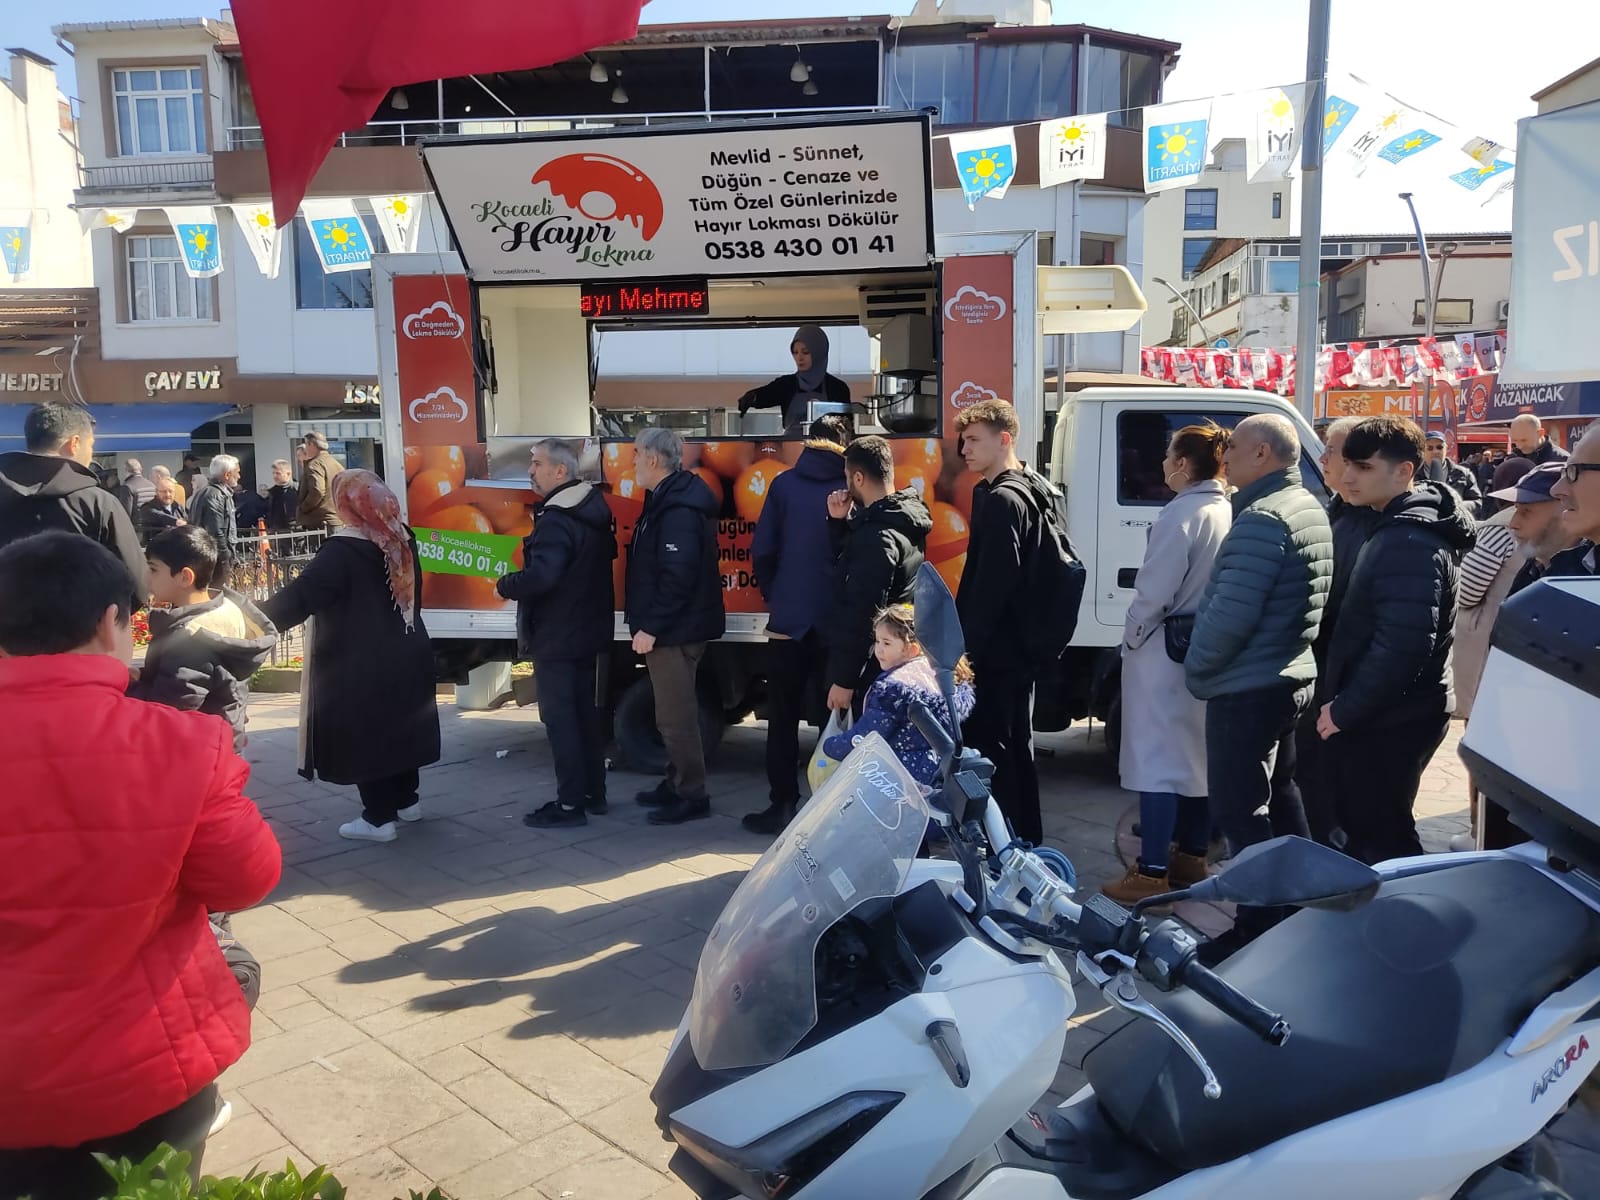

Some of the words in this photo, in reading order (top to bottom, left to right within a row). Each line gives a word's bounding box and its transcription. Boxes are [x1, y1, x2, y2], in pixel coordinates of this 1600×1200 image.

[710, 148, 771, 166] Mevlid
[793, 144, 864, 162] Sünnet,
[701, 173, 762, 191] Düğün
[783, 170, 851, 185] Cenaze
[857, 170, 879, 181] ve
[471, 198, 554, 226] Kocaeli
[689, 197, 727, 212] Tüm
[734, 193, 773, 210] Özel
[780, 189, 897, 207] Günlerinizde
[492, 216, 616, 254] Hayır
[694, 219, 742, 235] Hayır
[749, 216, 821, 231] Lokması
[828, 212, 899, 227] Dökülür
[576, 245, 655, 267] Lokma
[705, 240, 765, 259] 0538
[774, 238, 822, 257] 430
[832, 236, 858, 255] 01
[869, 235, 894, 253] 41
[620, 287, 706, 310] Mehme
[422, 320, 454, 330] Değmeden
[144, 371, 182, 397] ÇAY
[185, 364, 221, 390] EVİ
[1494, 385, 1565, 407] KAZANACAK
[448, 549, 473, 568] 430
[477, 556, 490, 572] 01
[494, 561, 508, 576] 41
[1531, 1034, 1589, 1104] ARORA
